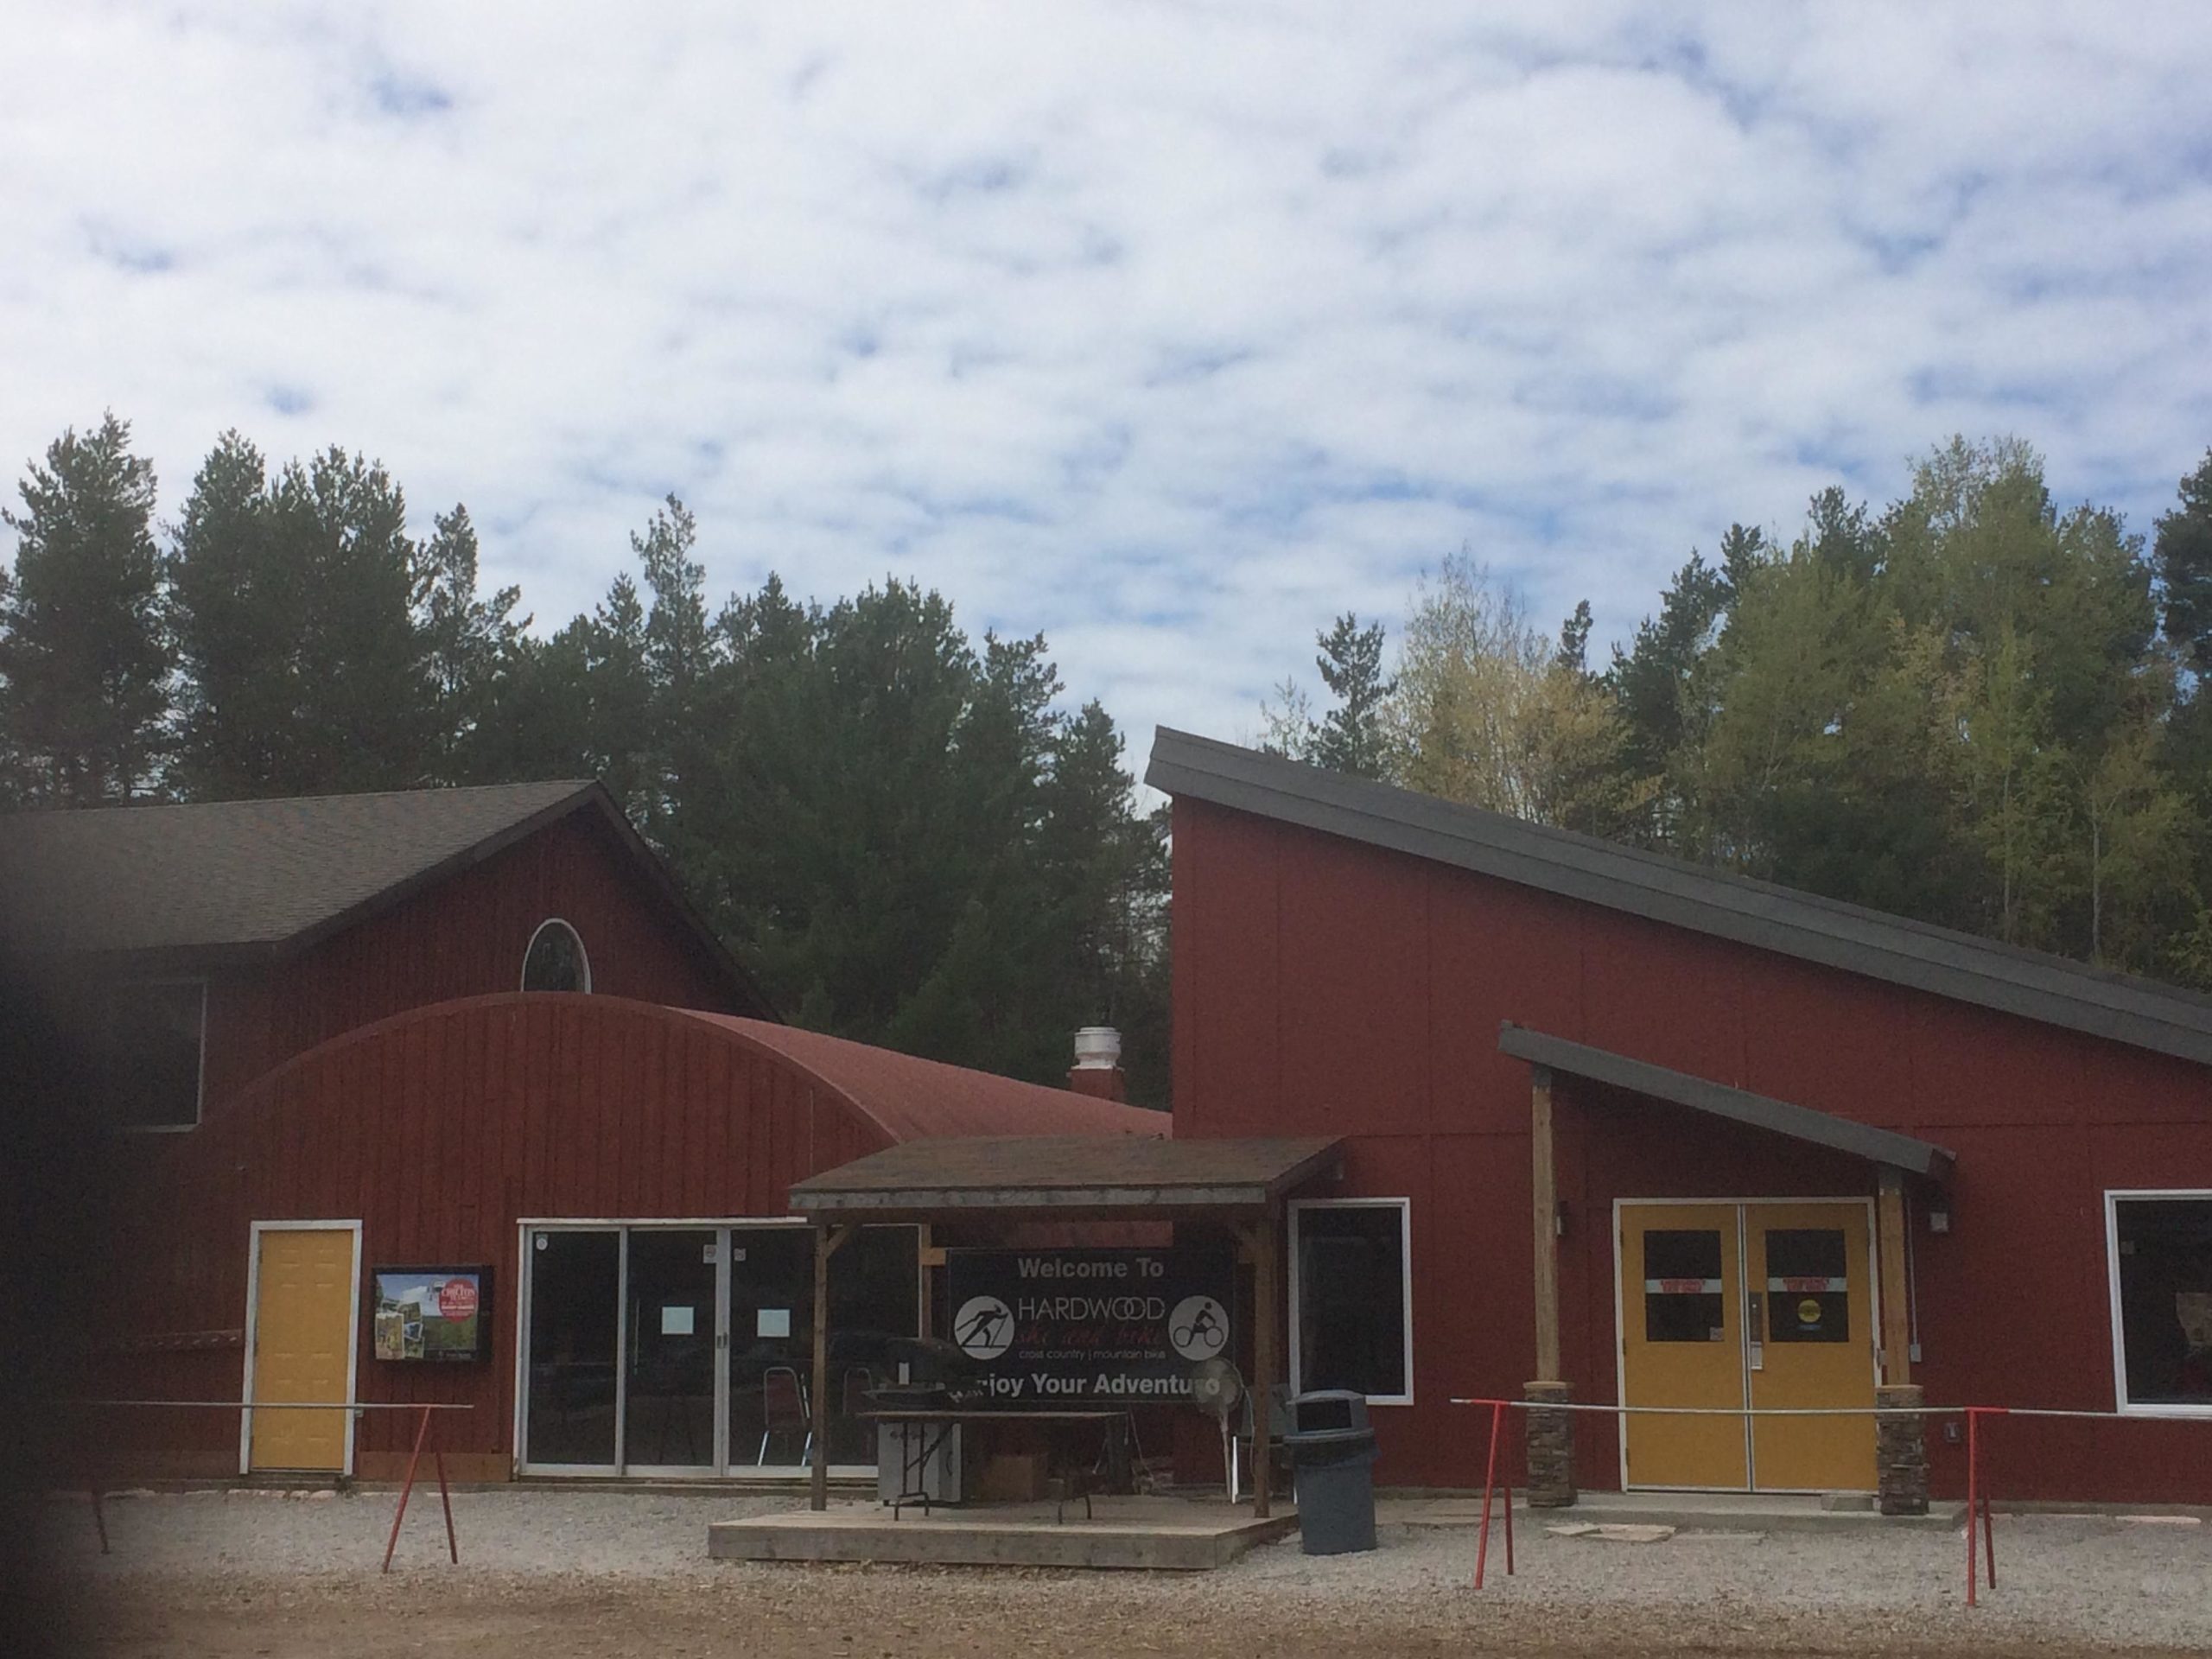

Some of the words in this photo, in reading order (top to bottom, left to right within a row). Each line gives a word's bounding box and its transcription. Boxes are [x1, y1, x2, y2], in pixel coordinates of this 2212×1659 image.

[1017, 1257, 1128, 1278] Welcome
[1135, 1257, 1165, 1278] To
[1018, 1296, 1166, 1320] HARDWOOD
[1018, 1350, 1045, 1359] cross
[1046, 1349, 1086, 1361] country
[1093, 1350, 1143, 1359] mountain
[1143, 1349, 1166, 1359] bike
[977, 1373, 1025, 1398] joy
[1031, 1373, 1087, 1394] Your
[1093, 1372, 1201, 1395] Adventu
